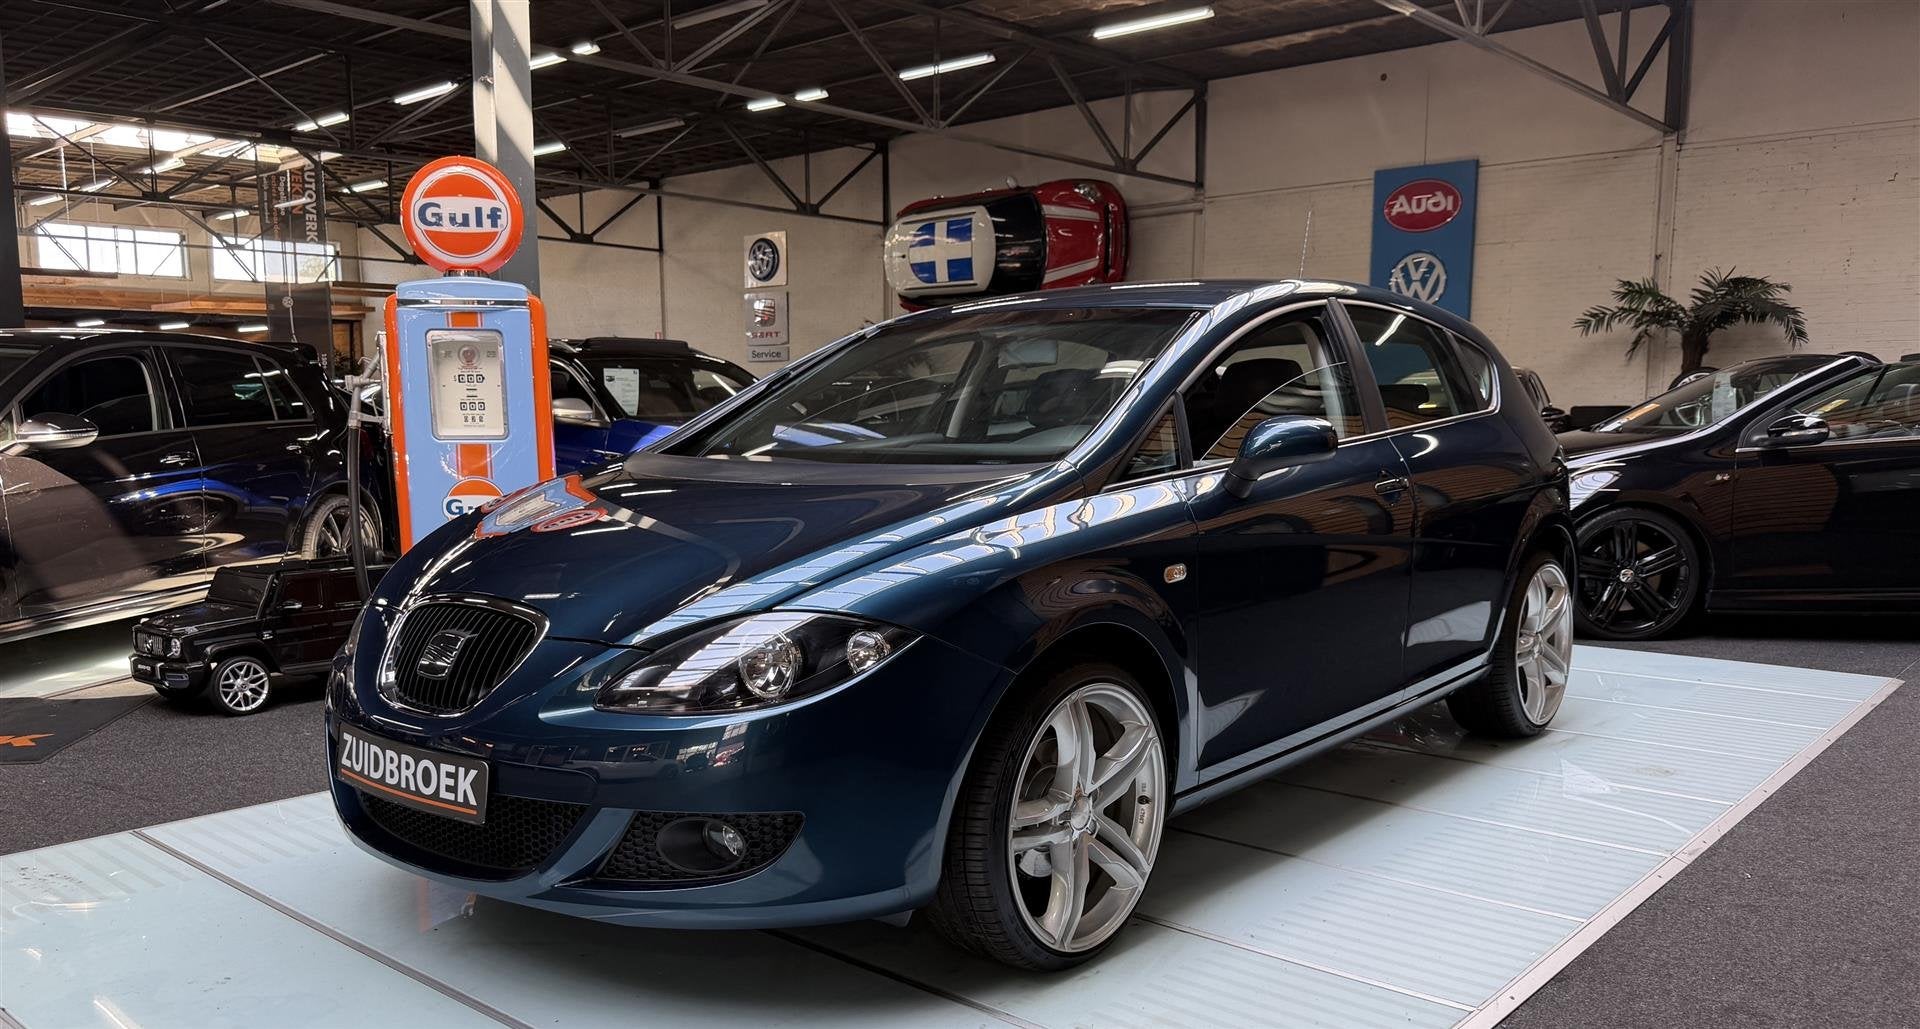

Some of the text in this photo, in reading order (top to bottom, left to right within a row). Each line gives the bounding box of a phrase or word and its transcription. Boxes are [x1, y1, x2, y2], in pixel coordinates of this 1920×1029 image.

[418, 202, 502, 228] Gulf
[752, 350, 782, 359] Service
[341, 732, 478, 806] ZUIDBROEK
